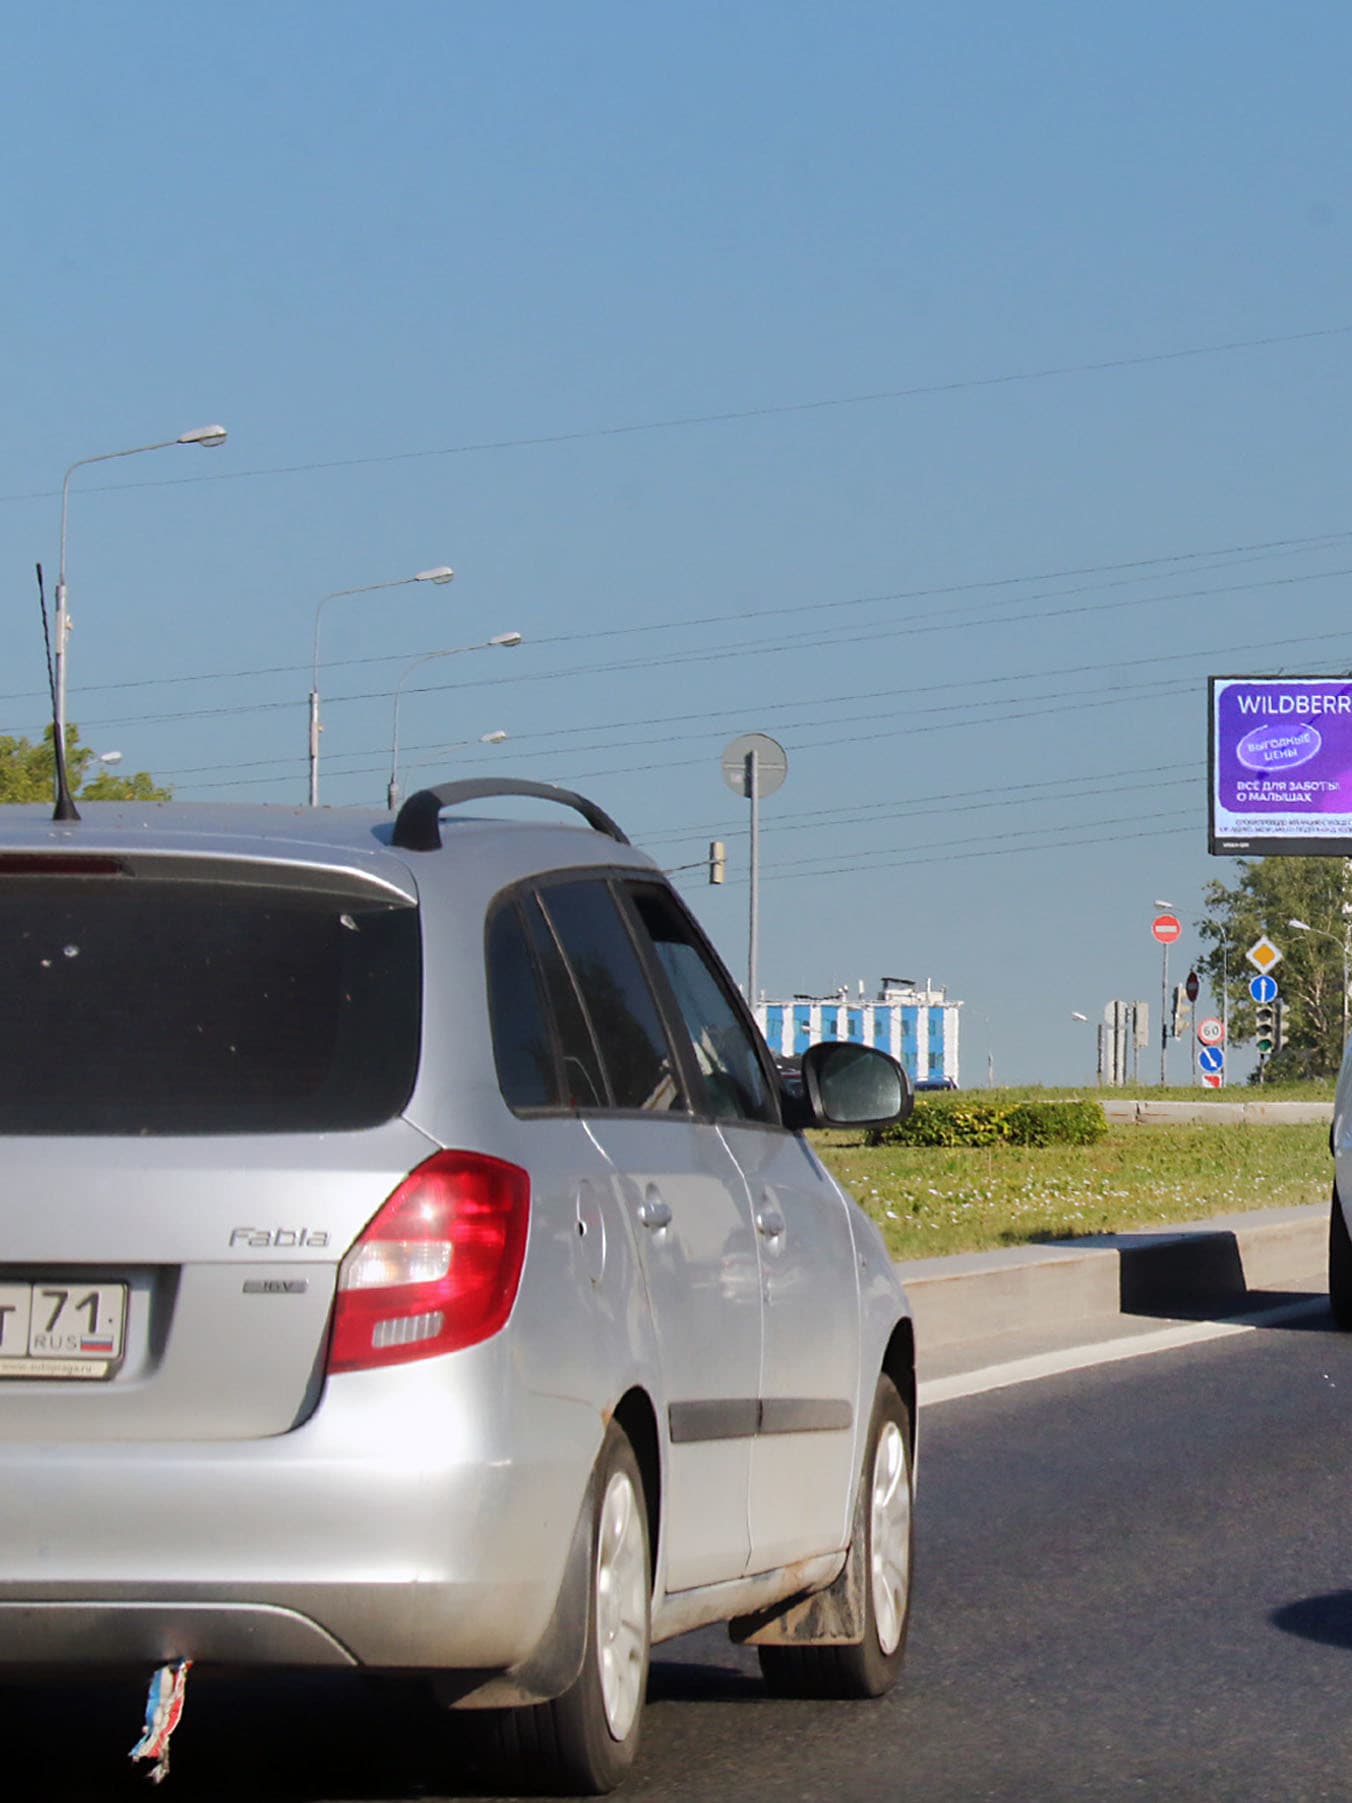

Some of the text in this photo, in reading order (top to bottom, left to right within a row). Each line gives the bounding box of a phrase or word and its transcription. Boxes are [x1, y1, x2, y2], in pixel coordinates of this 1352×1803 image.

[1263, 748, 1298, 761] ЦЕНЫ
[1262, 781, 1286, 792] ДЛЯ
[1289, 781, 1340, 792] ЗАБОТЫ
[1236, 793, 1312, 803] О МАЛЫШАХ
[1203, 1025, 1220, 1037] 60
[229, 1227, 329, 1247] Fabia
[42, 1289, 99, 1334] 71
[34, 1335, 77, 1349] RUS
